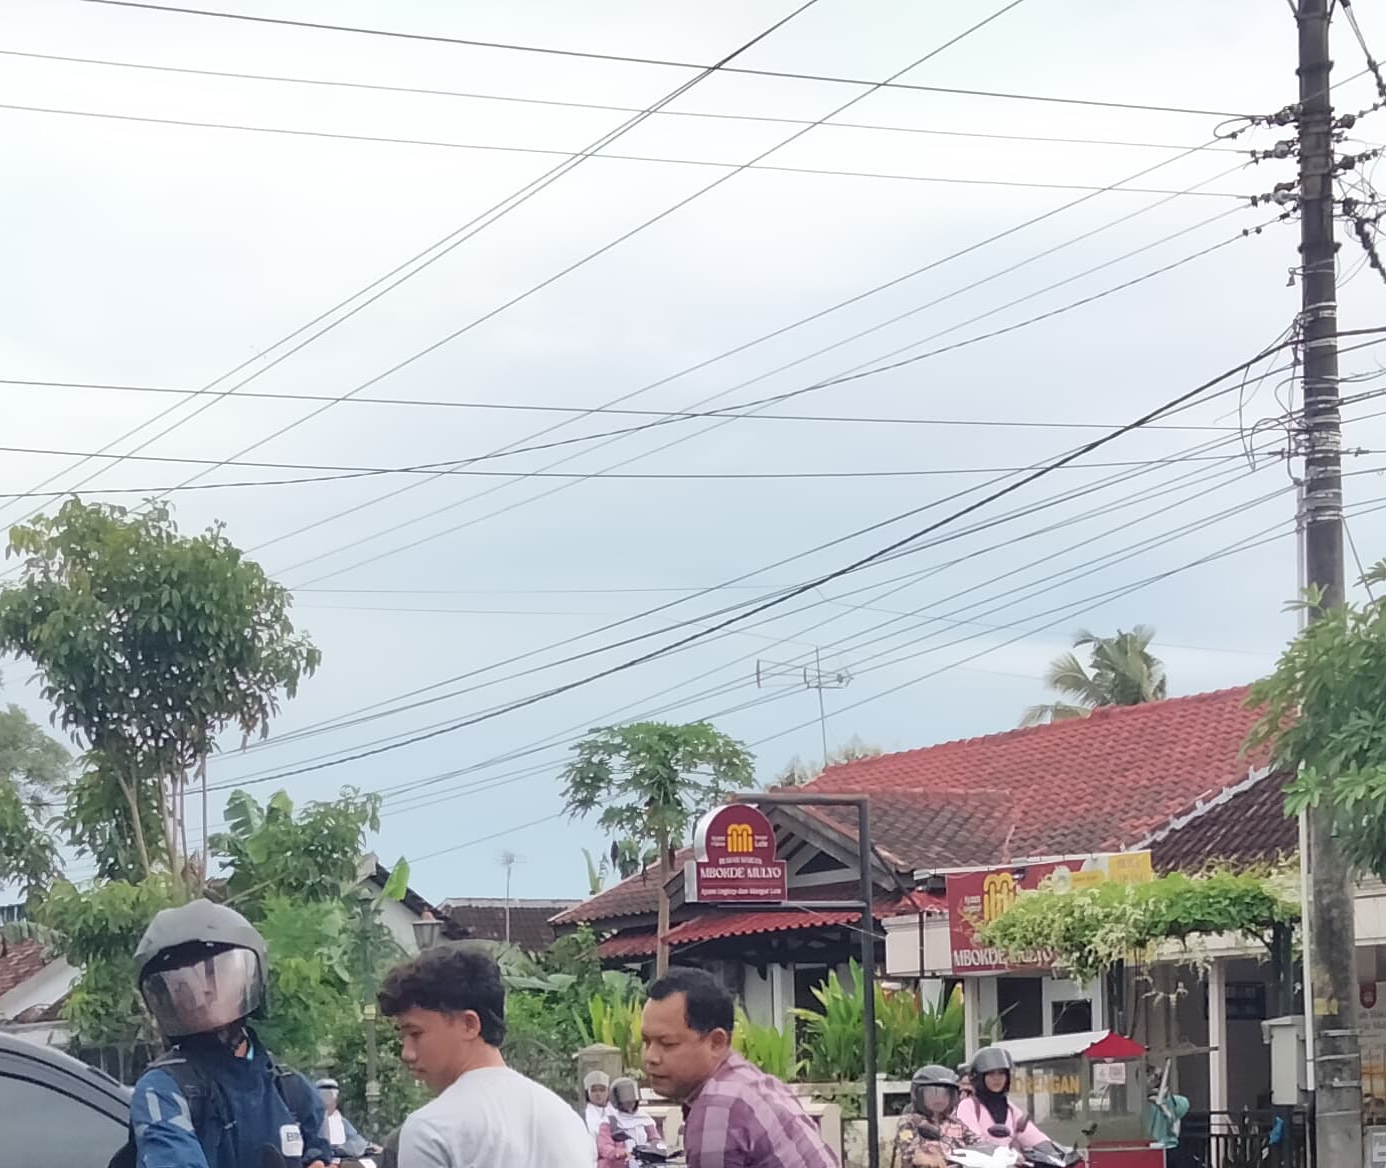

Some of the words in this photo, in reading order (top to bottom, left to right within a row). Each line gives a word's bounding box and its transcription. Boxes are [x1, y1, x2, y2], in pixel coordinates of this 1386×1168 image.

[700, 866, 745, 879] MBOKDE
[747, 866, 782, 879] MULYO
[953, 948, 1006, 967] MBOKDE
